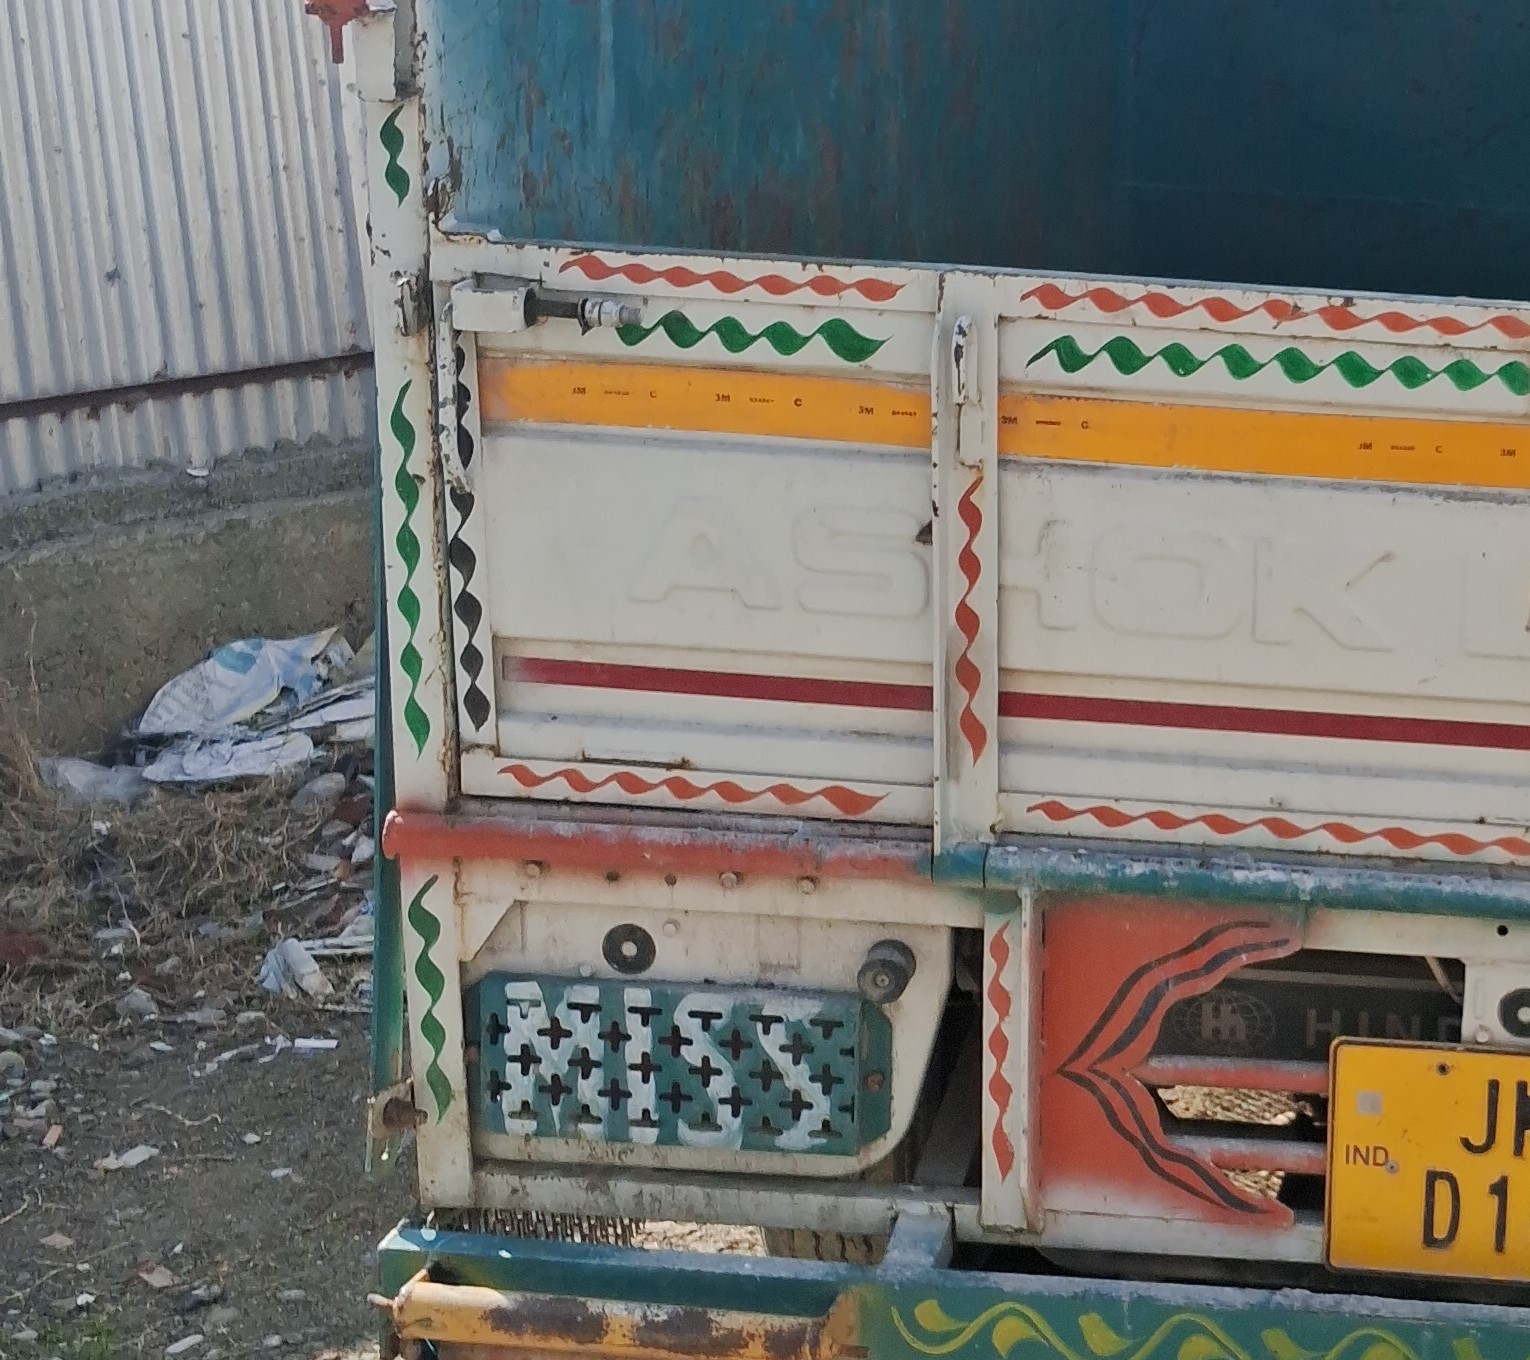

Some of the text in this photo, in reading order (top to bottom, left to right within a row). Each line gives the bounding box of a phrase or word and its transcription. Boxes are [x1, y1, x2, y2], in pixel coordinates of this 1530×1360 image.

[715, 393, 731, 403] 3M
[857, 406, 875, 416] 3M
[628, 495, 1398, 654] ASHOK
[503, 980, 832, 1151] MISS
[1344, 1143, 1390, 1167] IND
